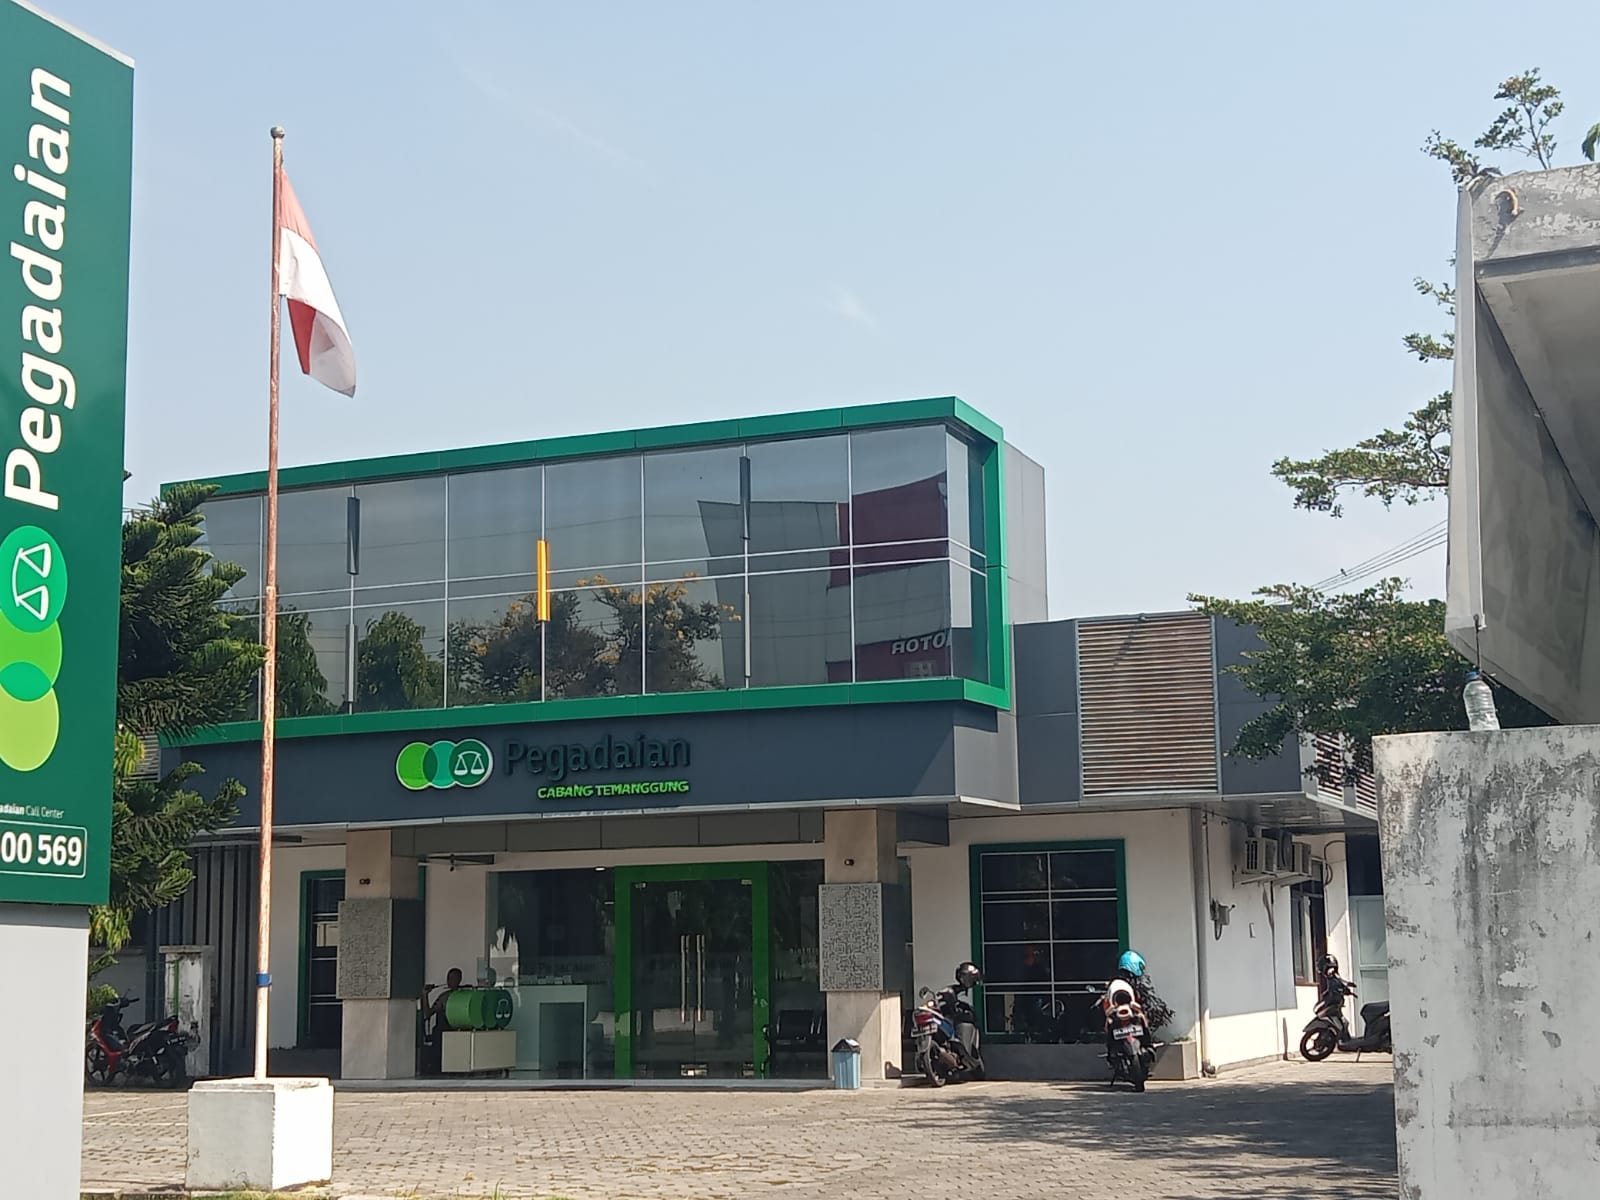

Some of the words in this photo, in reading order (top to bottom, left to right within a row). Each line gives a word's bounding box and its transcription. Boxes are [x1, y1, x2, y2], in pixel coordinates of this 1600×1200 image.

[4, 66, 77, 510] Pegadaian
[503, 733, 690, 781] Pegadaian
[537, 784, 594, 799] CABANG
[595, 780, 690, 796] TEMANGGUNG
[25, 805, 40, 817] Call
[40, 806, 65, 819] Center
[1, 831, 32, 864] 00
[37, 834, 82, 867] 569
